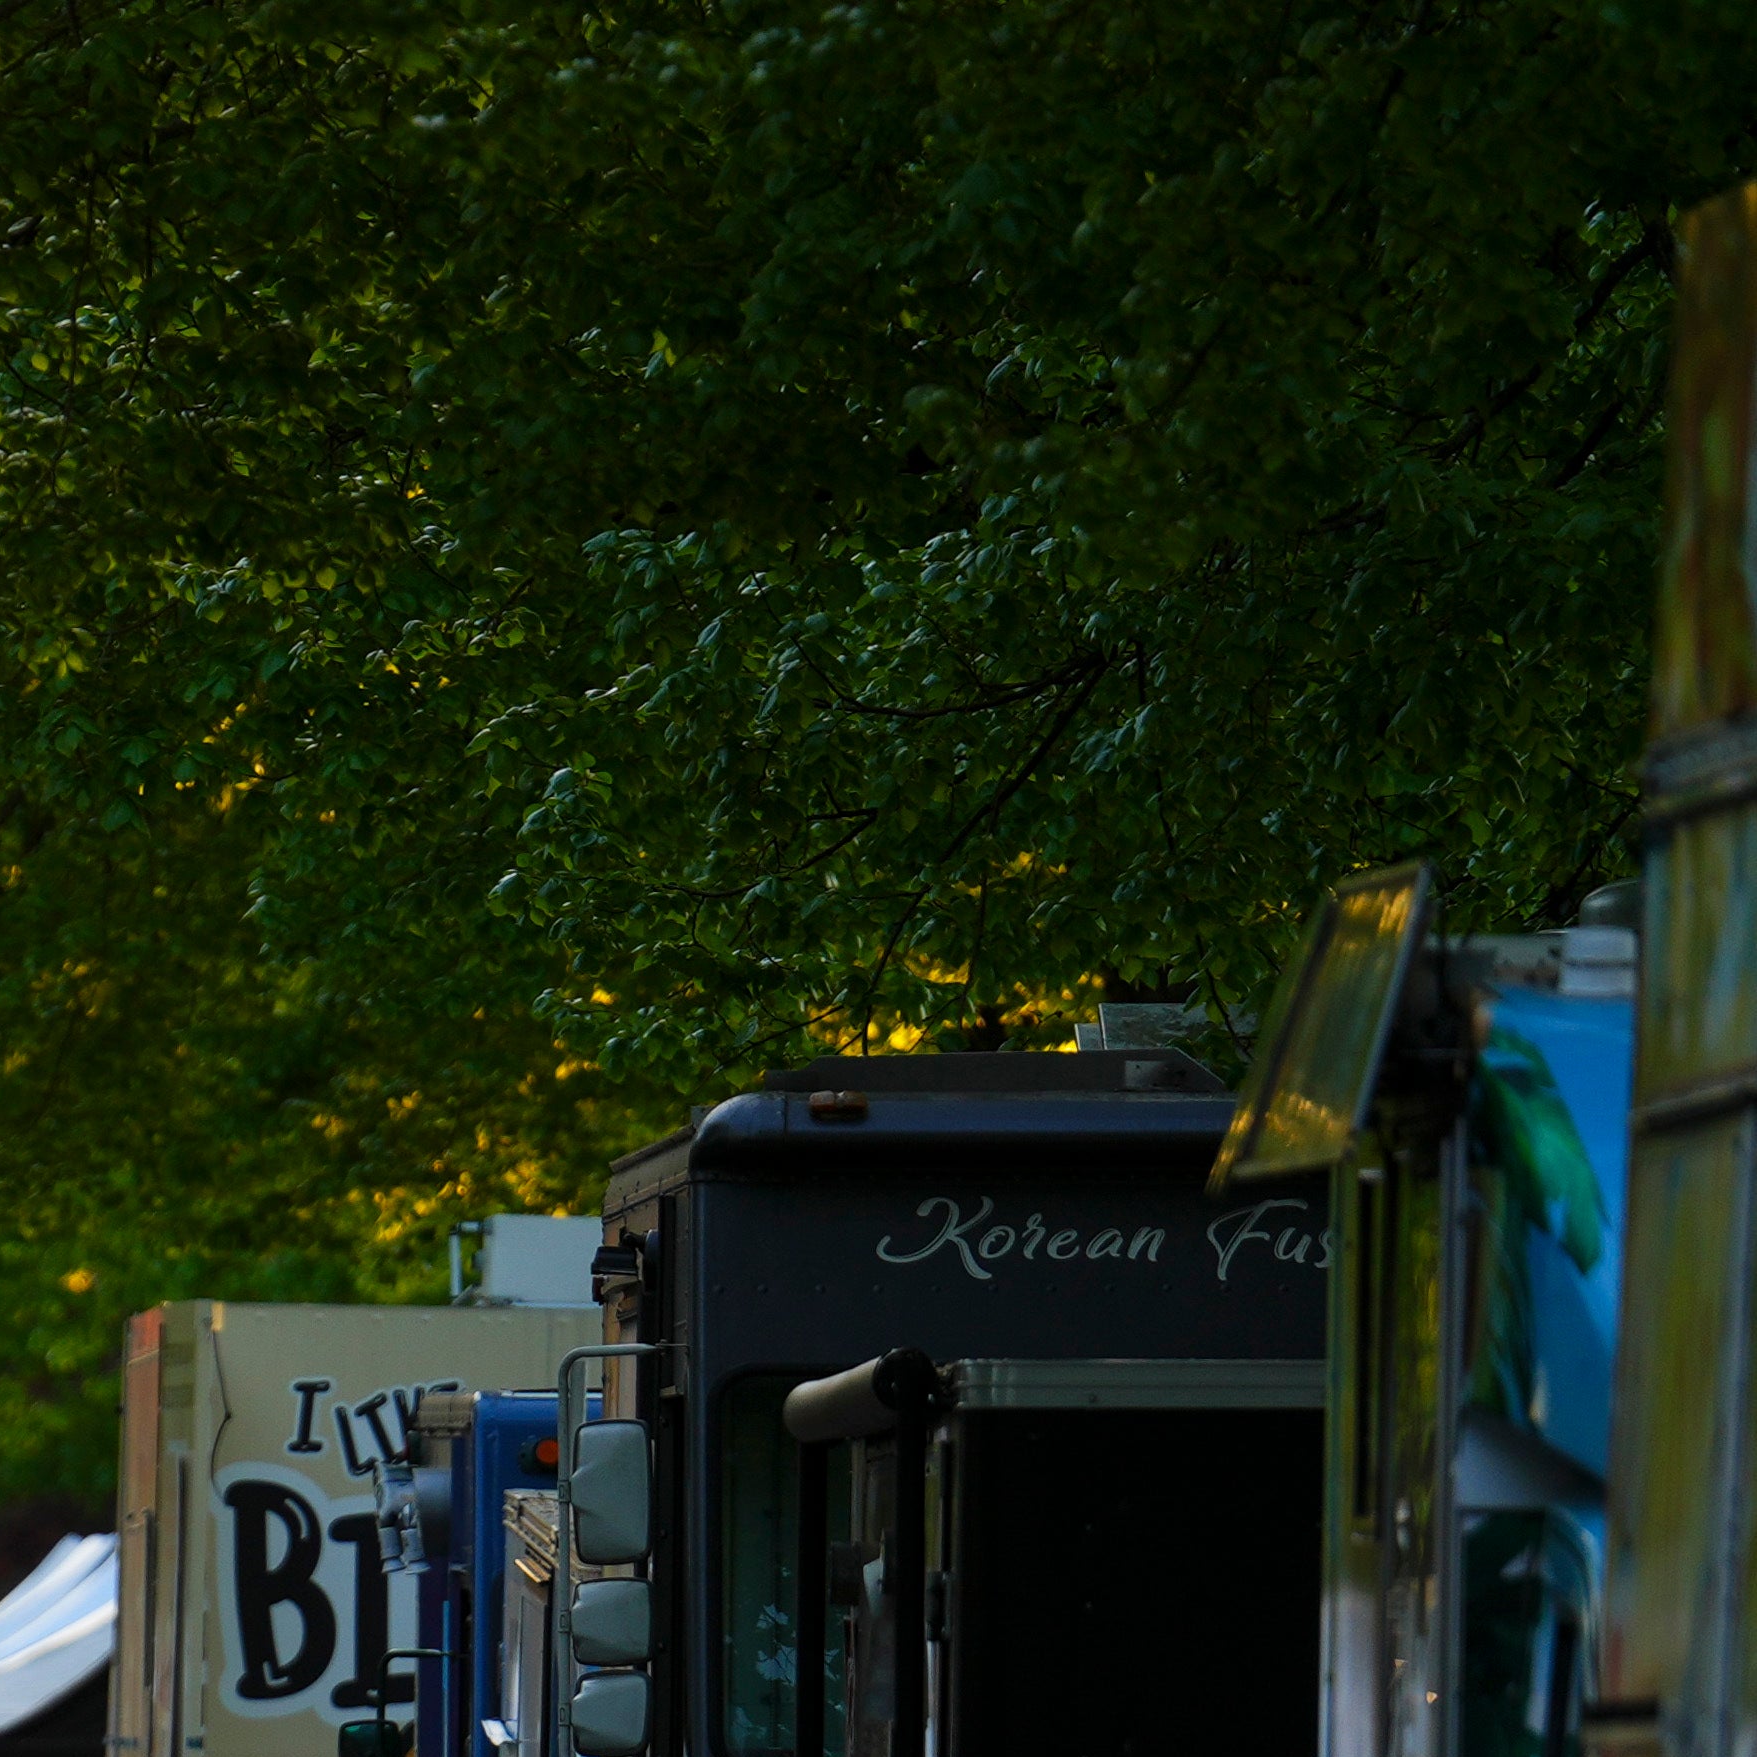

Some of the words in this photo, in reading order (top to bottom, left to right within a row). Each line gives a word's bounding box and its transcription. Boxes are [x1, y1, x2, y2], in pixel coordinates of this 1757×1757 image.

[876, 1196, 1166, 1281] Korean
[1205, 1198, 1335, 1282] Fus
[289, 1379, 331, 1453] I
